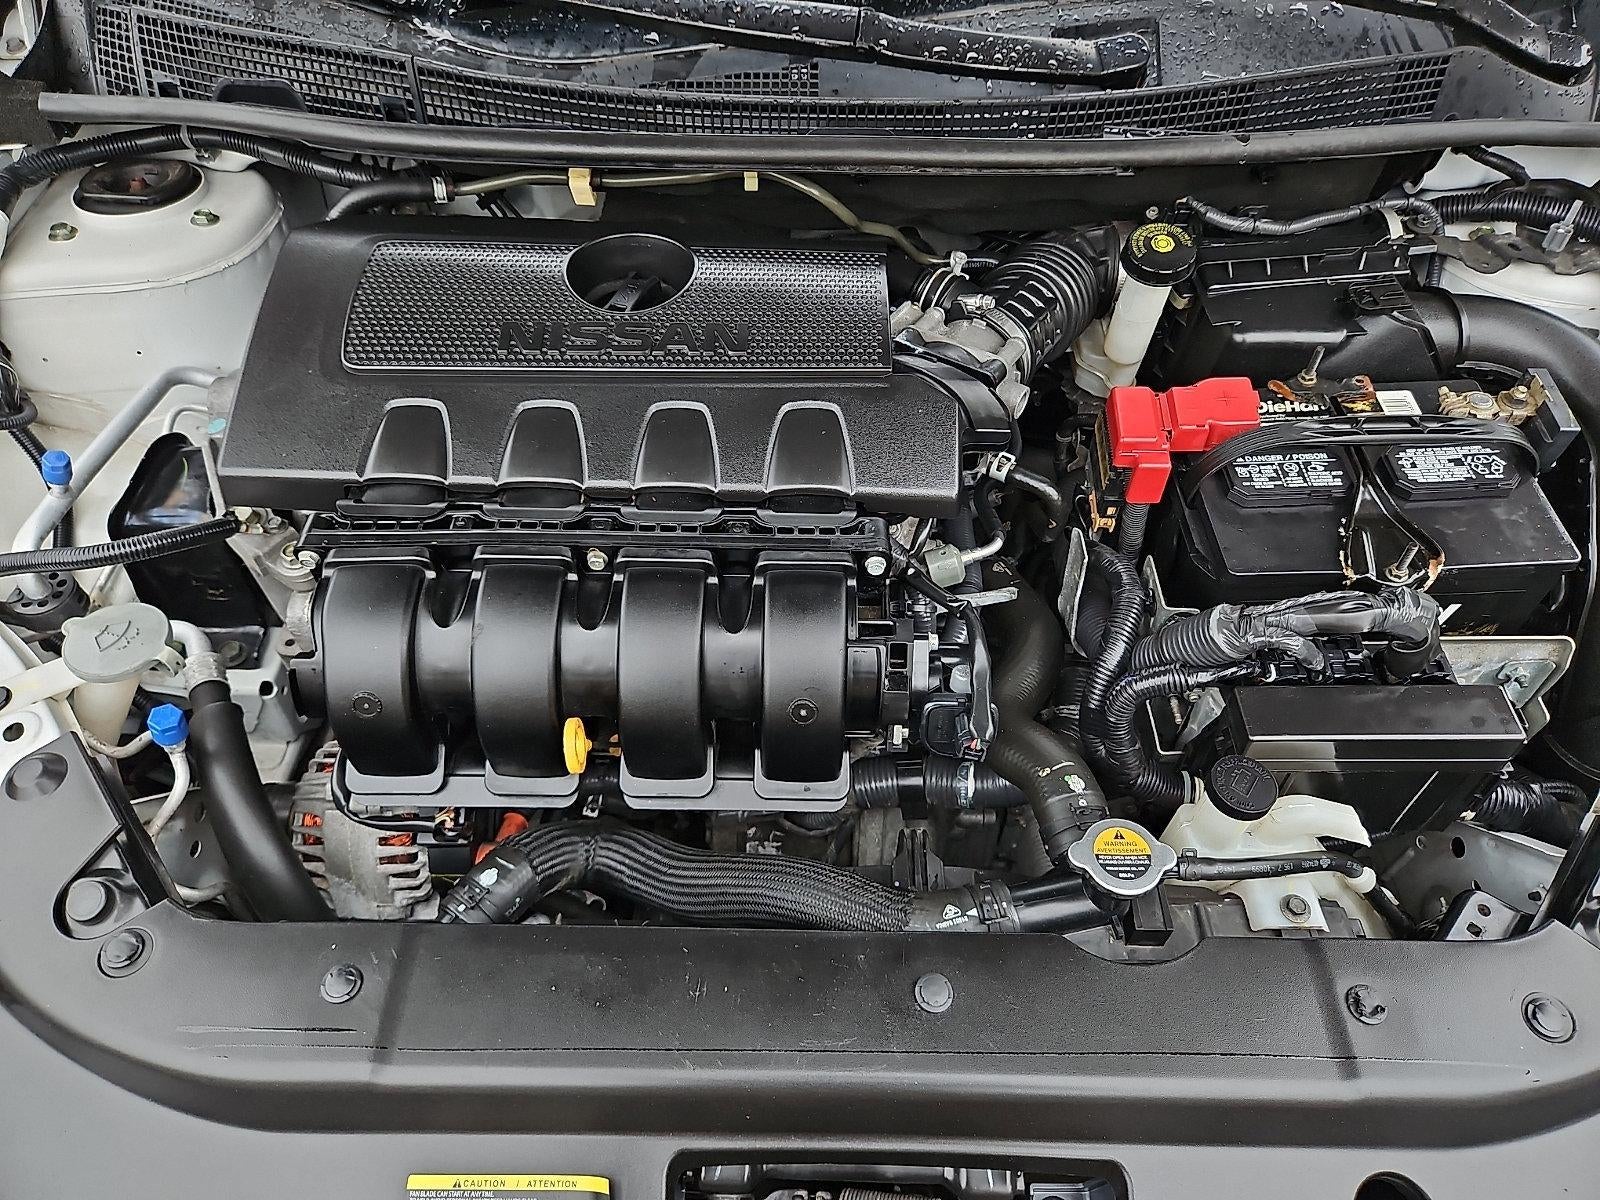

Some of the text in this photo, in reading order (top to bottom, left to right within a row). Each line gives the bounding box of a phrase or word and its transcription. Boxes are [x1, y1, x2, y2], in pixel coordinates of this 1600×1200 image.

[497, 320, 750, 355] NISSAN
[463, 1179, 506, 1188] CAUTION
[526, 1179, 578, 1188] ATTENTION
